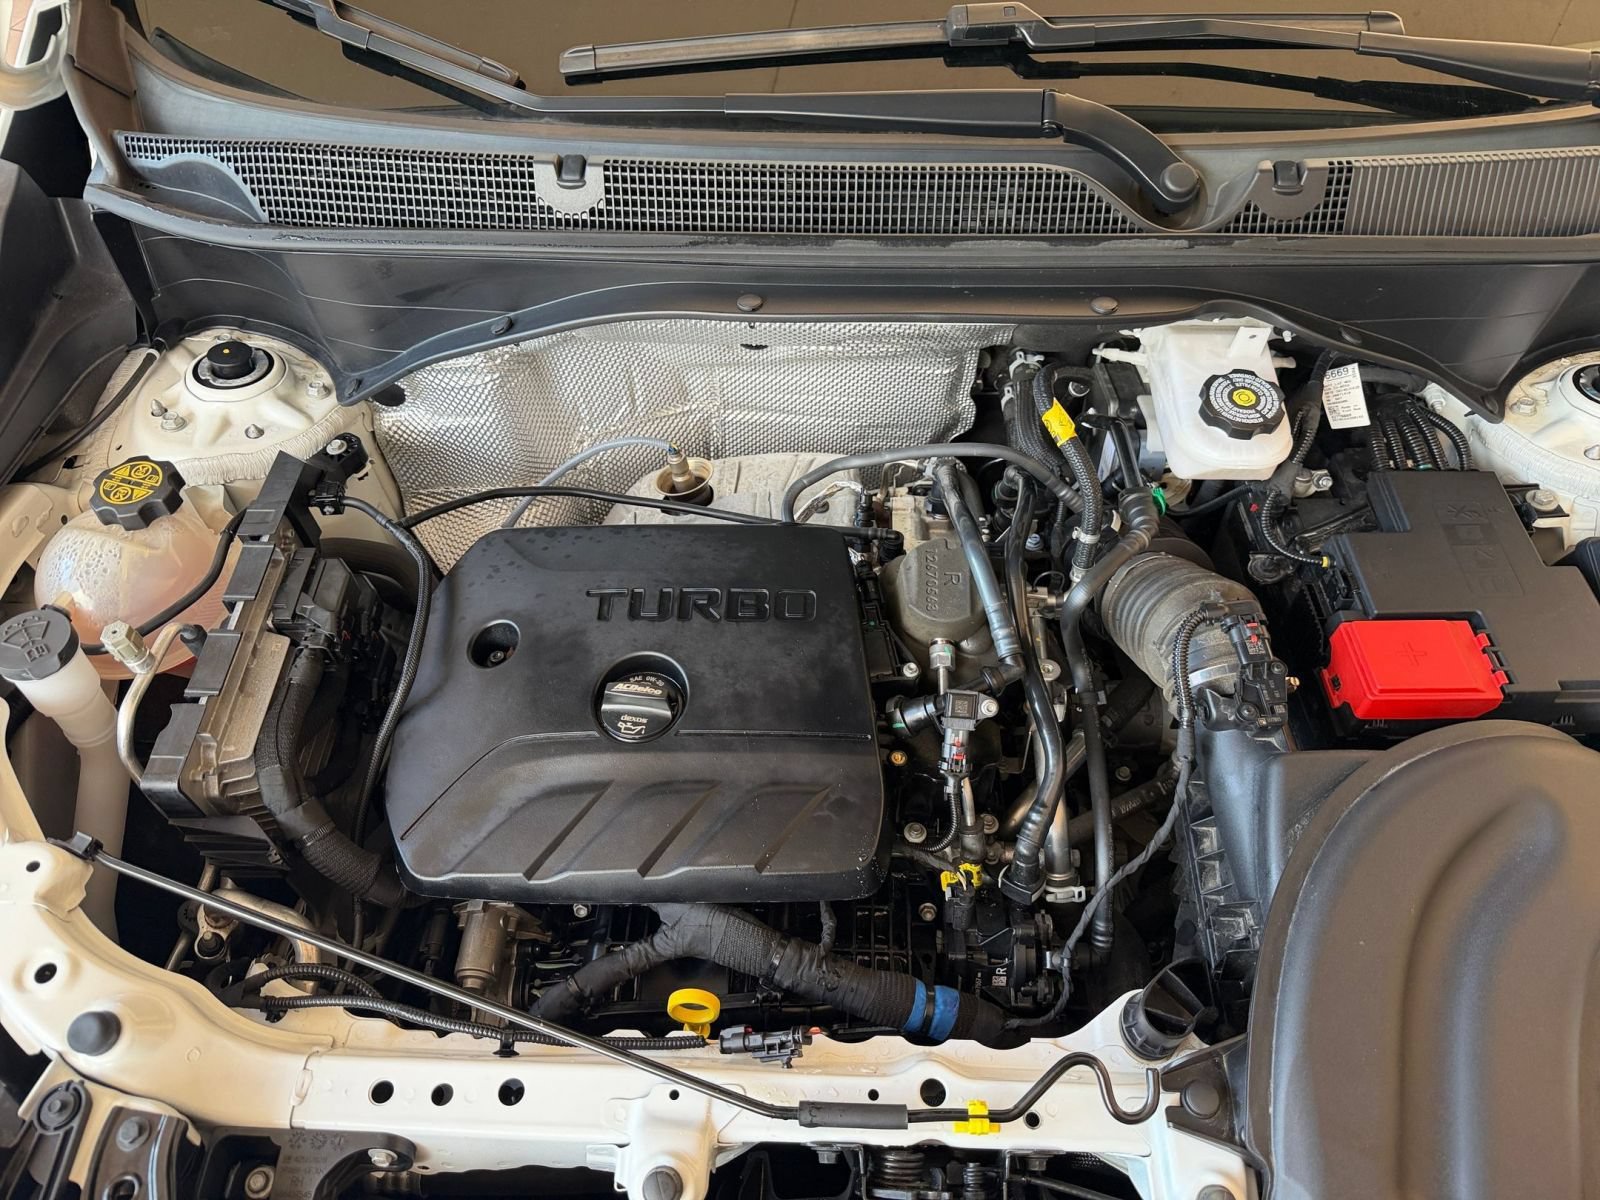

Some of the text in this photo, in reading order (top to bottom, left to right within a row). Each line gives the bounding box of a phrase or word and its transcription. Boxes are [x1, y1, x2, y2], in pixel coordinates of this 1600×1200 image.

[943, 571, 962, 587] R
[586, 587, 817, 623] TURBO
[629, 675, 643, 683] SAE
[610, 682, 663, 695] ACDelco
[620, 714, 649, 724] dexos
